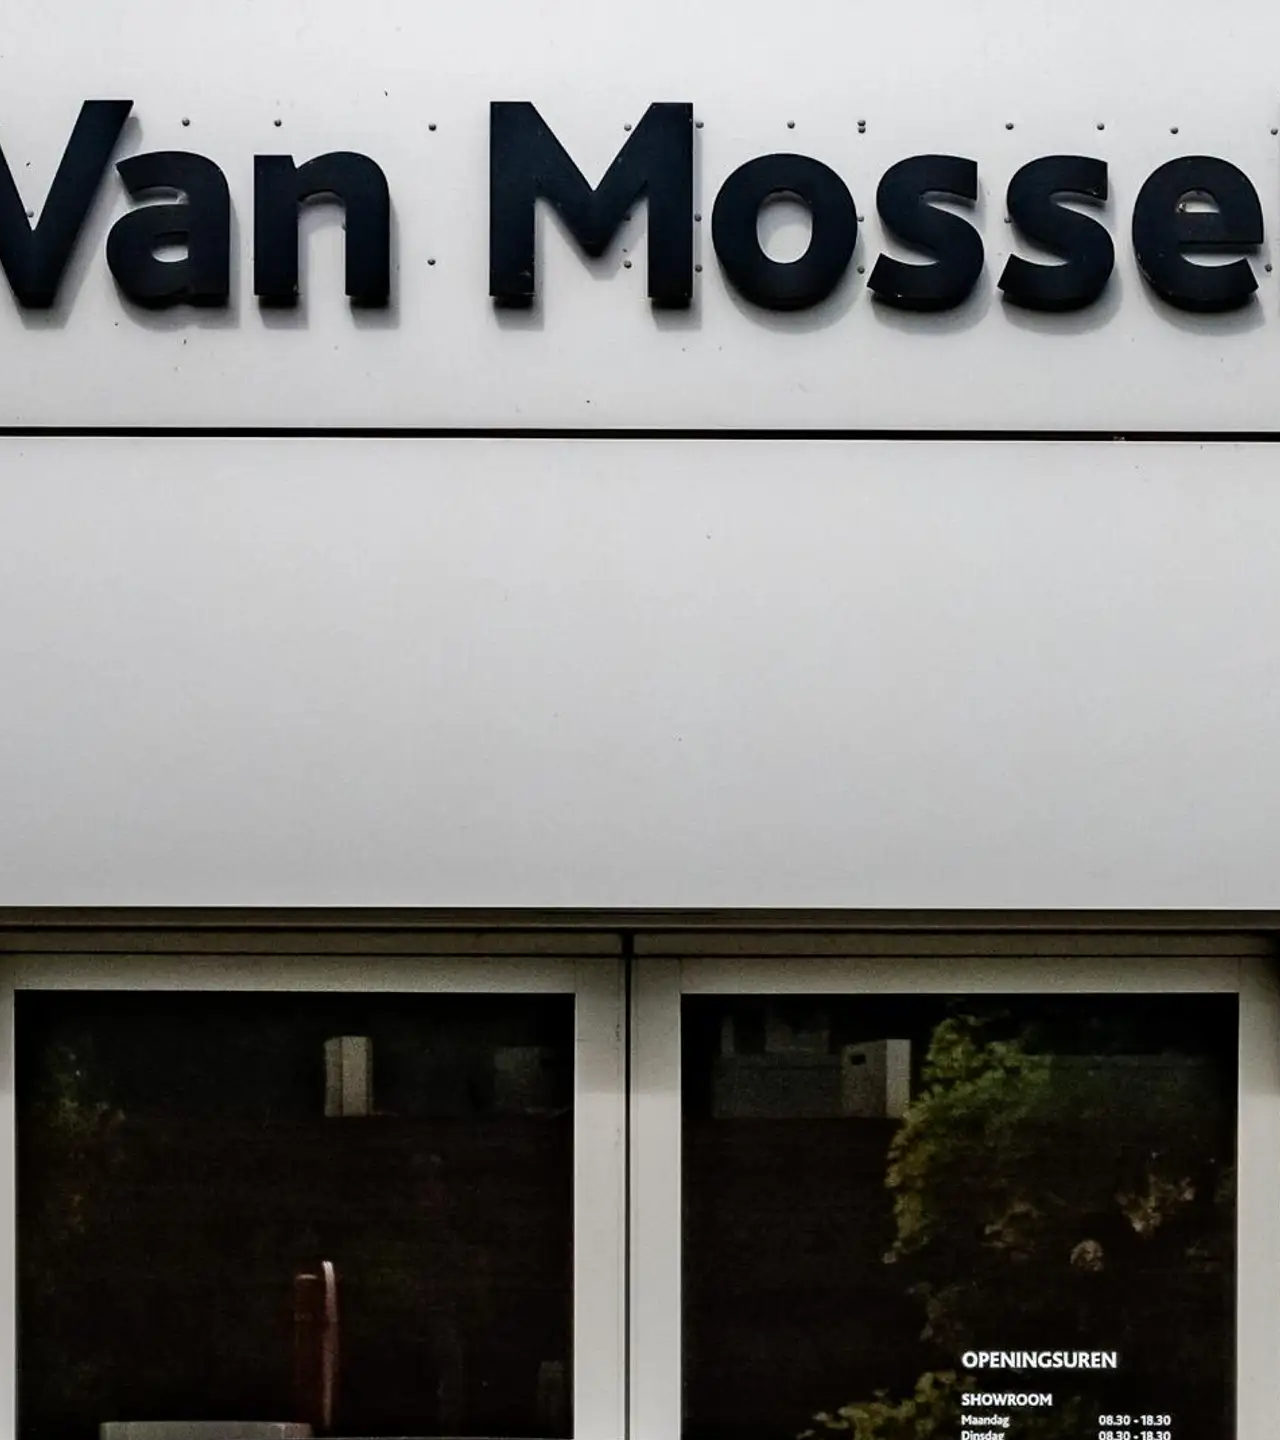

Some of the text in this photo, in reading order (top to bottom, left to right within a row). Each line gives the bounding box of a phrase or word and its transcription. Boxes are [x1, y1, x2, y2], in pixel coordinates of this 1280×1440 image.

[961, 1351, 1118, 1369] OPENINGSUREN
[961, 1392, 1053, 1407] SHOWROOM
[961, 1414, 1010, 1427] Maandag
[1099, 1415, 1130, 1426] 08.30
[1141, 1415, 1171, 1426] 18.30
